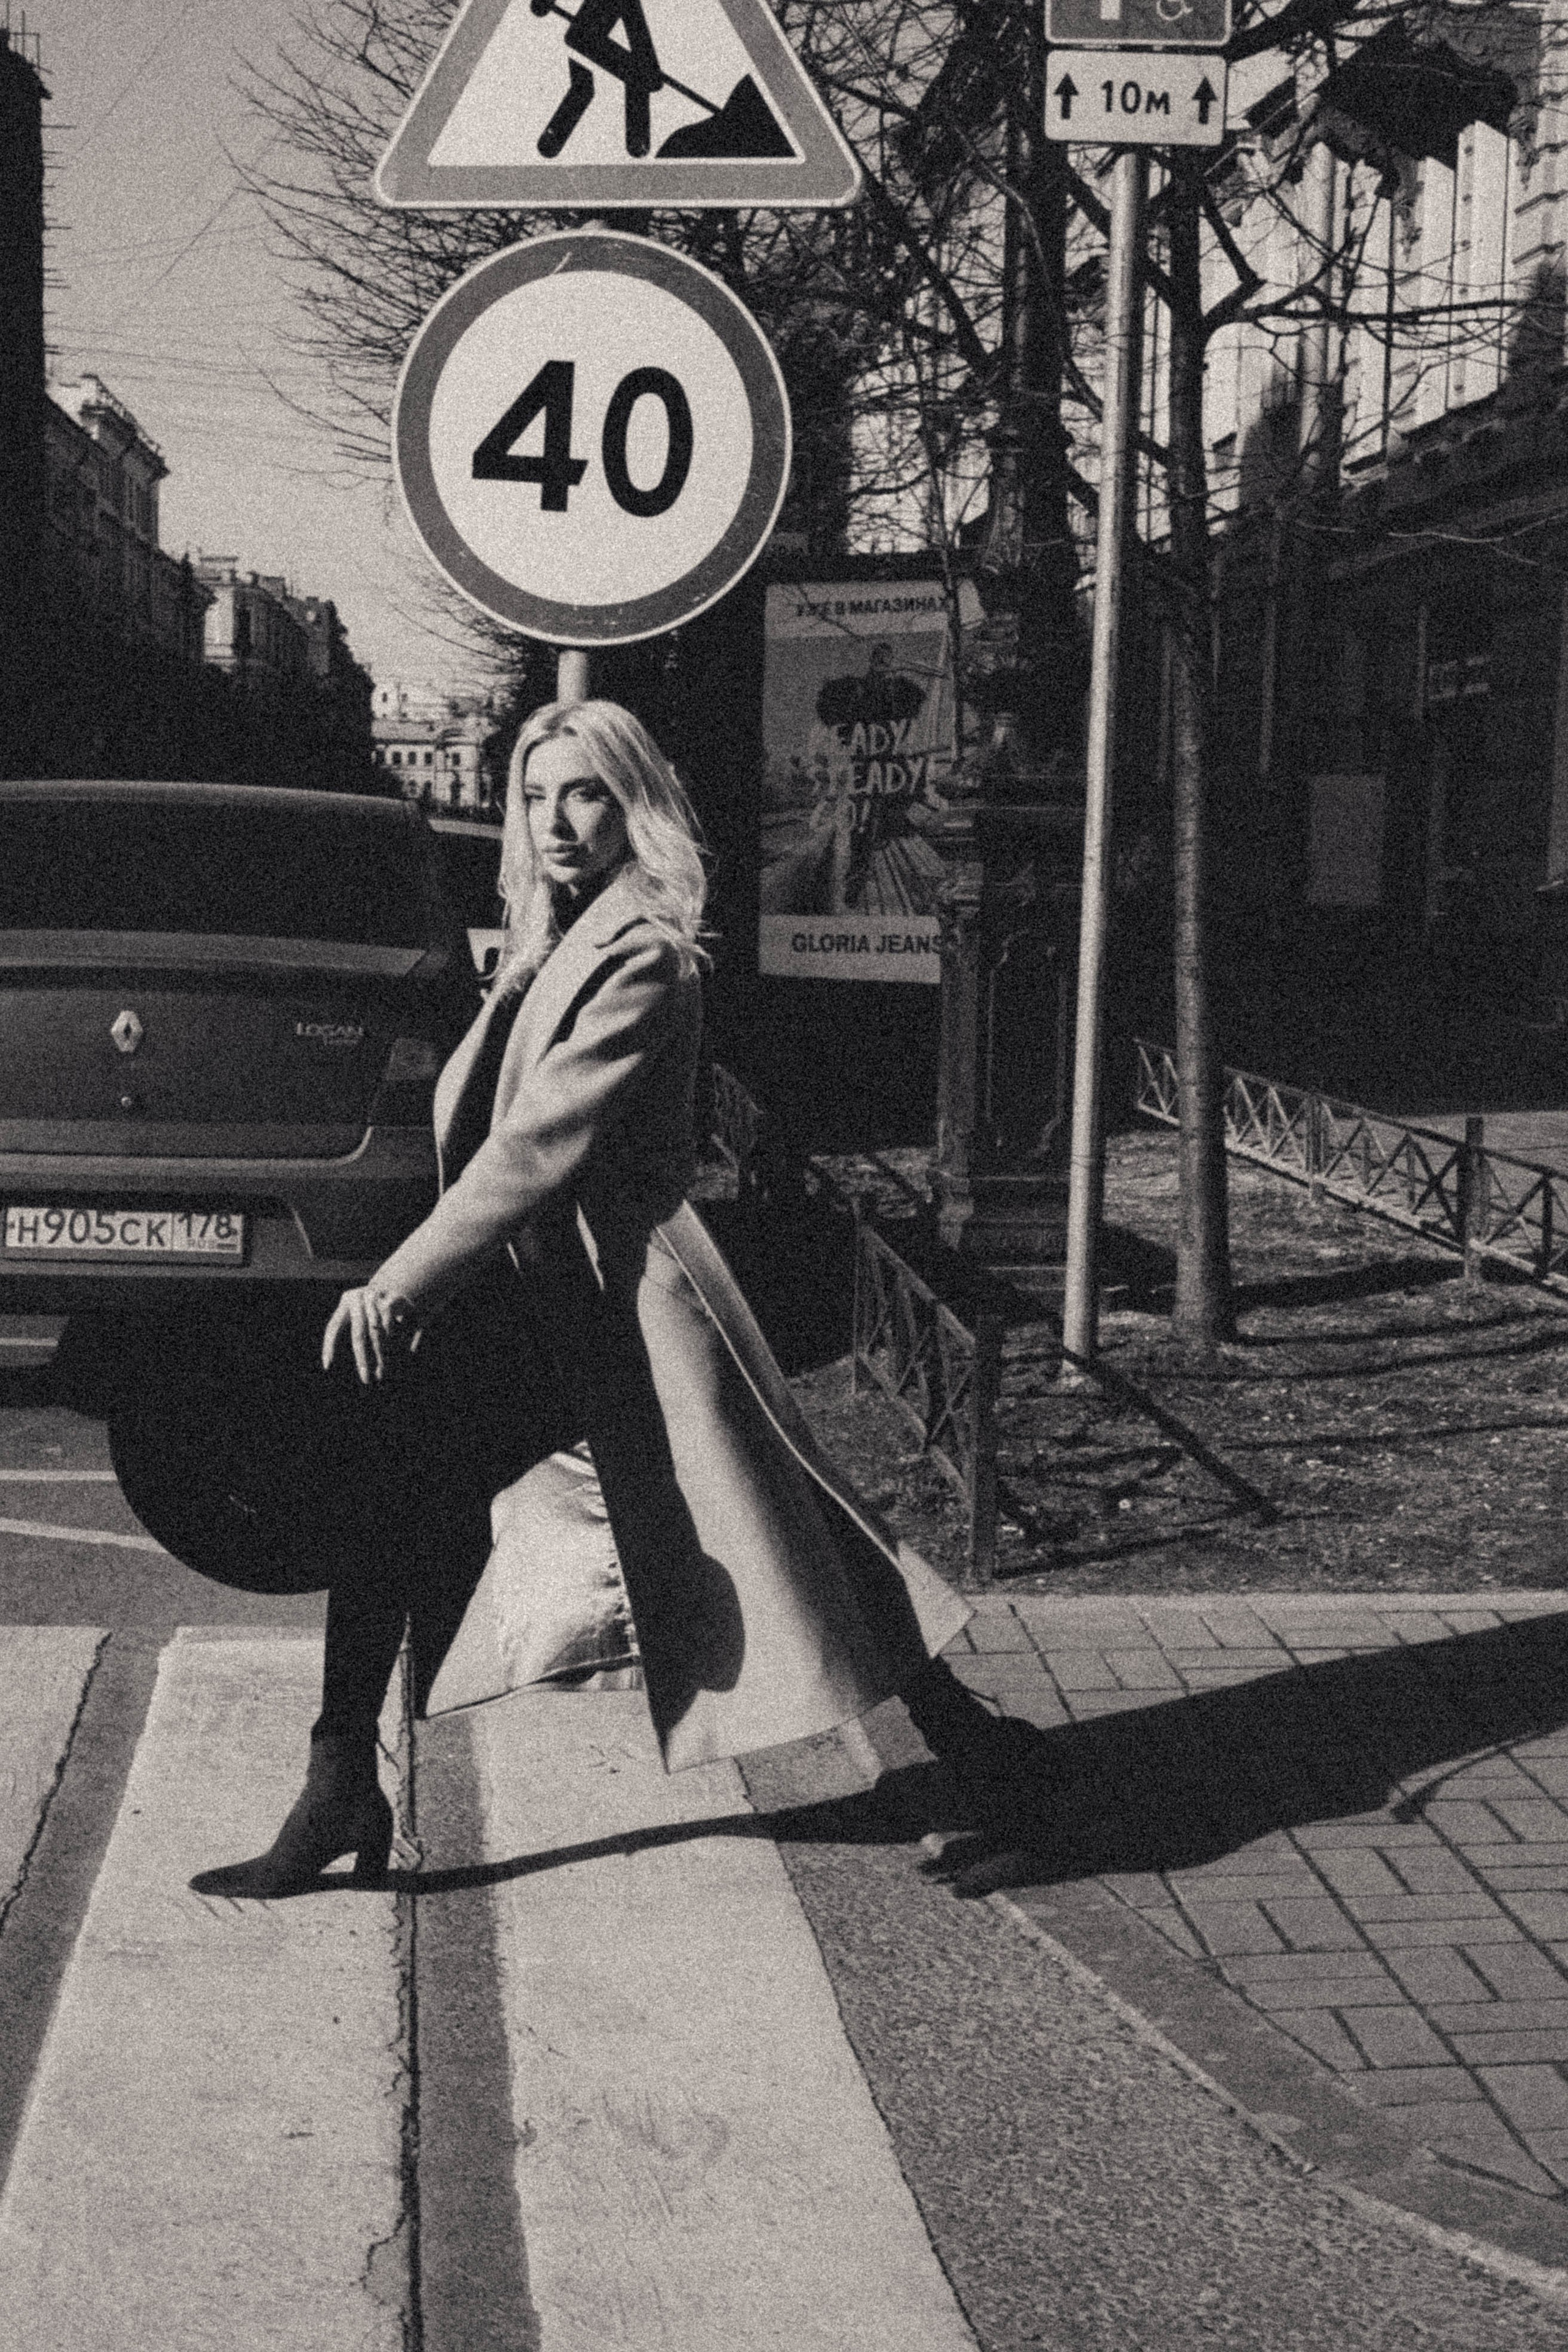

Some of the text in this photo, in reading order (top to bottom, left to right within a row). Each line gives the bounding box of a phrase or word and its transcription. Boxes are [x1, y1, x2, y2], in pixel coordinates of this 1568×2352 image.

[471, 359, 694, 518] 40
[791, 932, 942, 955] GLORIA JEANS
